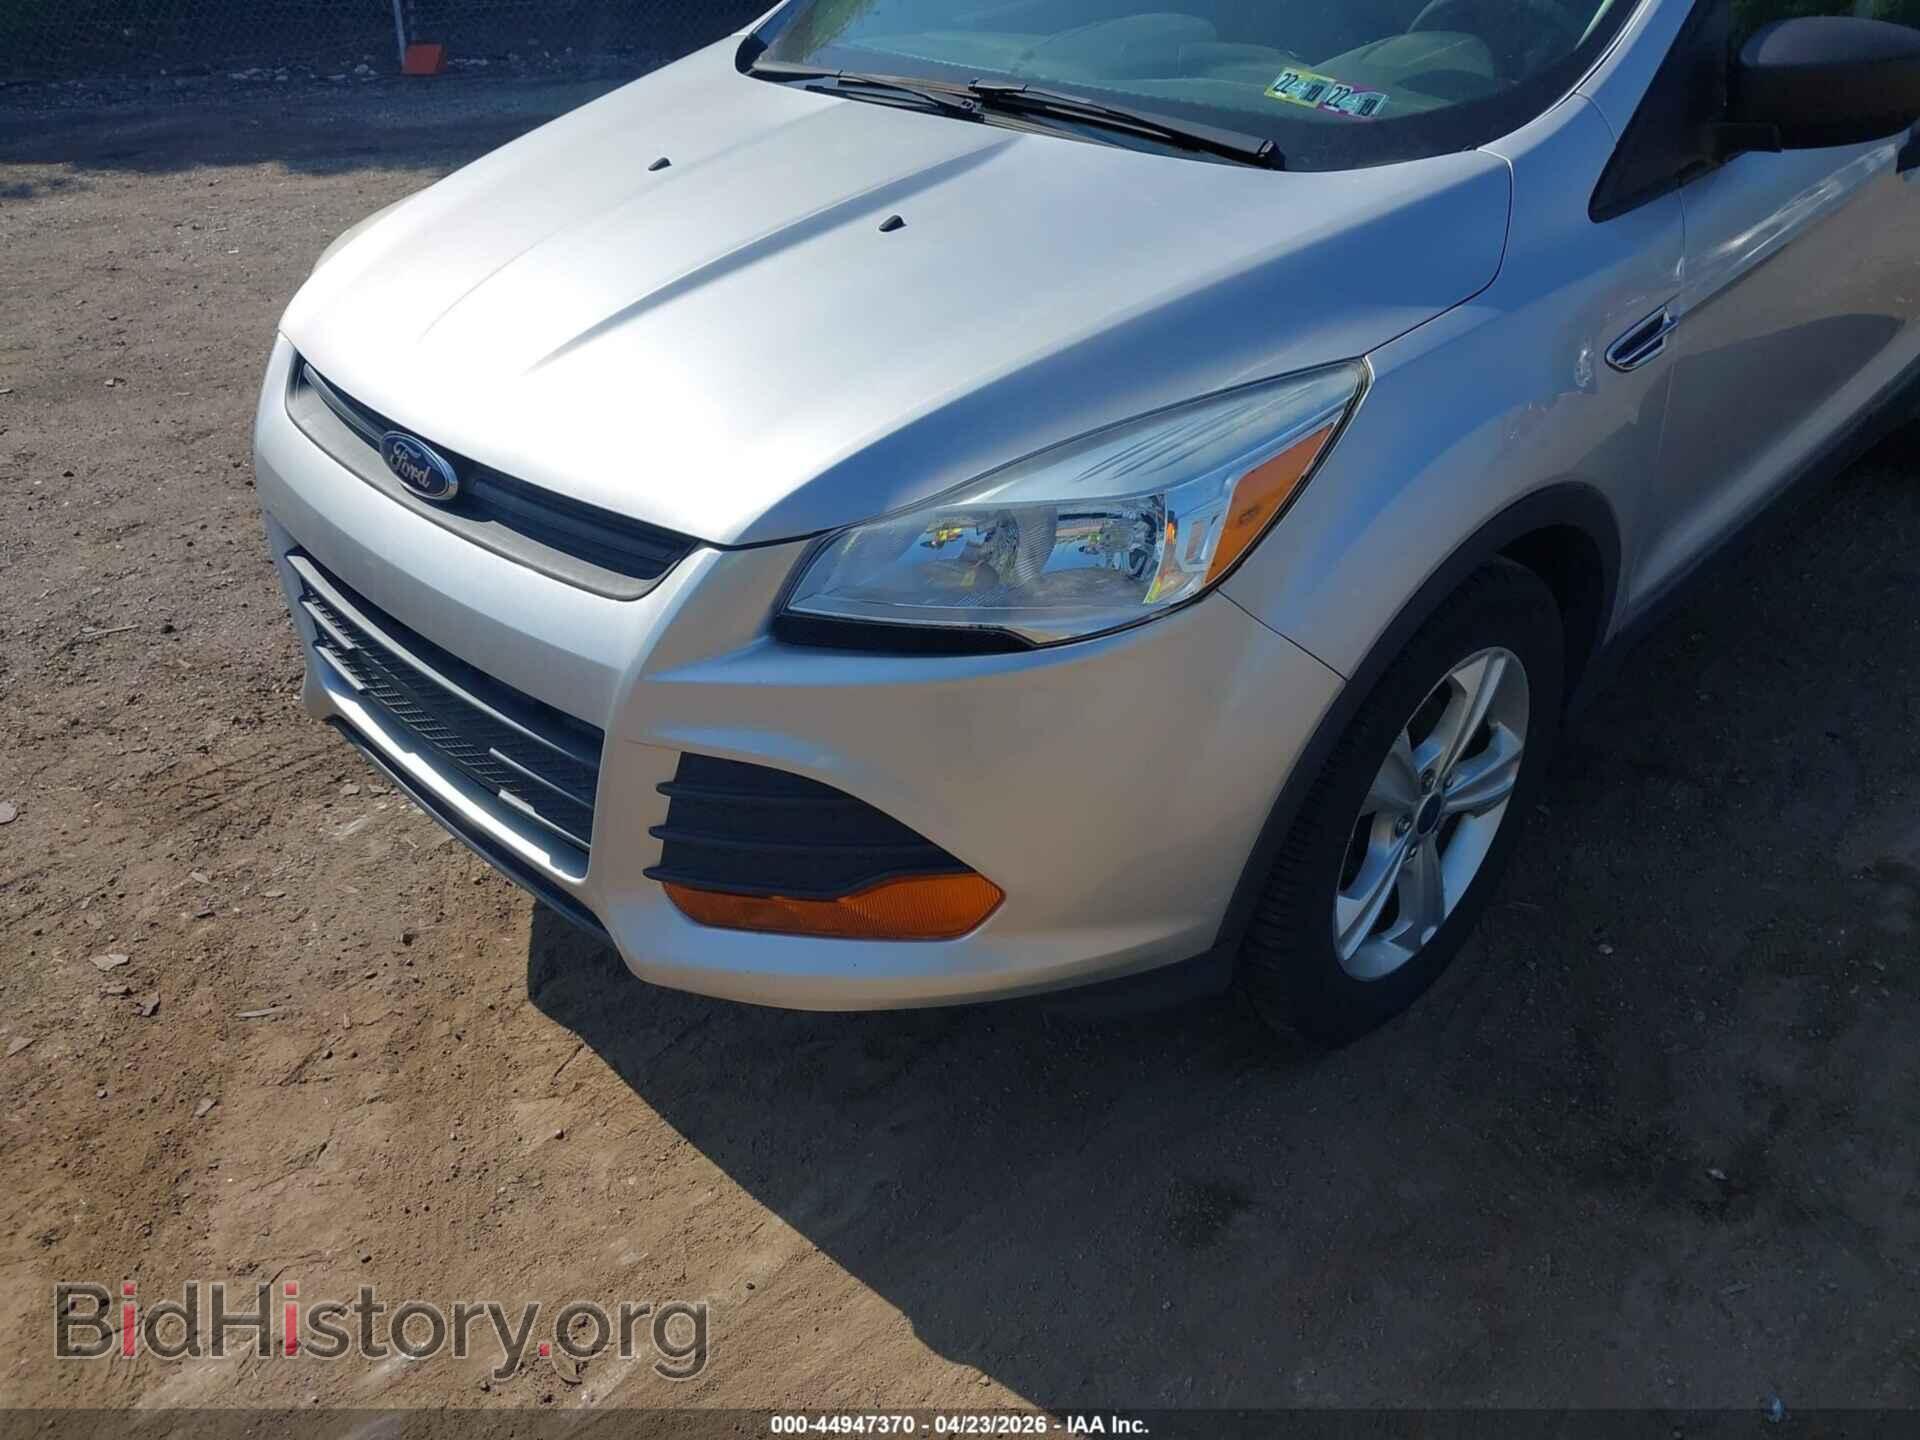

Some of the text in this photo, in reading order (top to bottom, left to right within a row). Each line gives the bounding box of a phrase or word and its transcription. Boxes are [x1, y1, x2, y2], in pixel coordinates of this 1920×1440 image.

[1272, 72, 1299, 94] 22
[1325, 86, 1351, 108] 22
[390, 440, 432, 489] Ford
